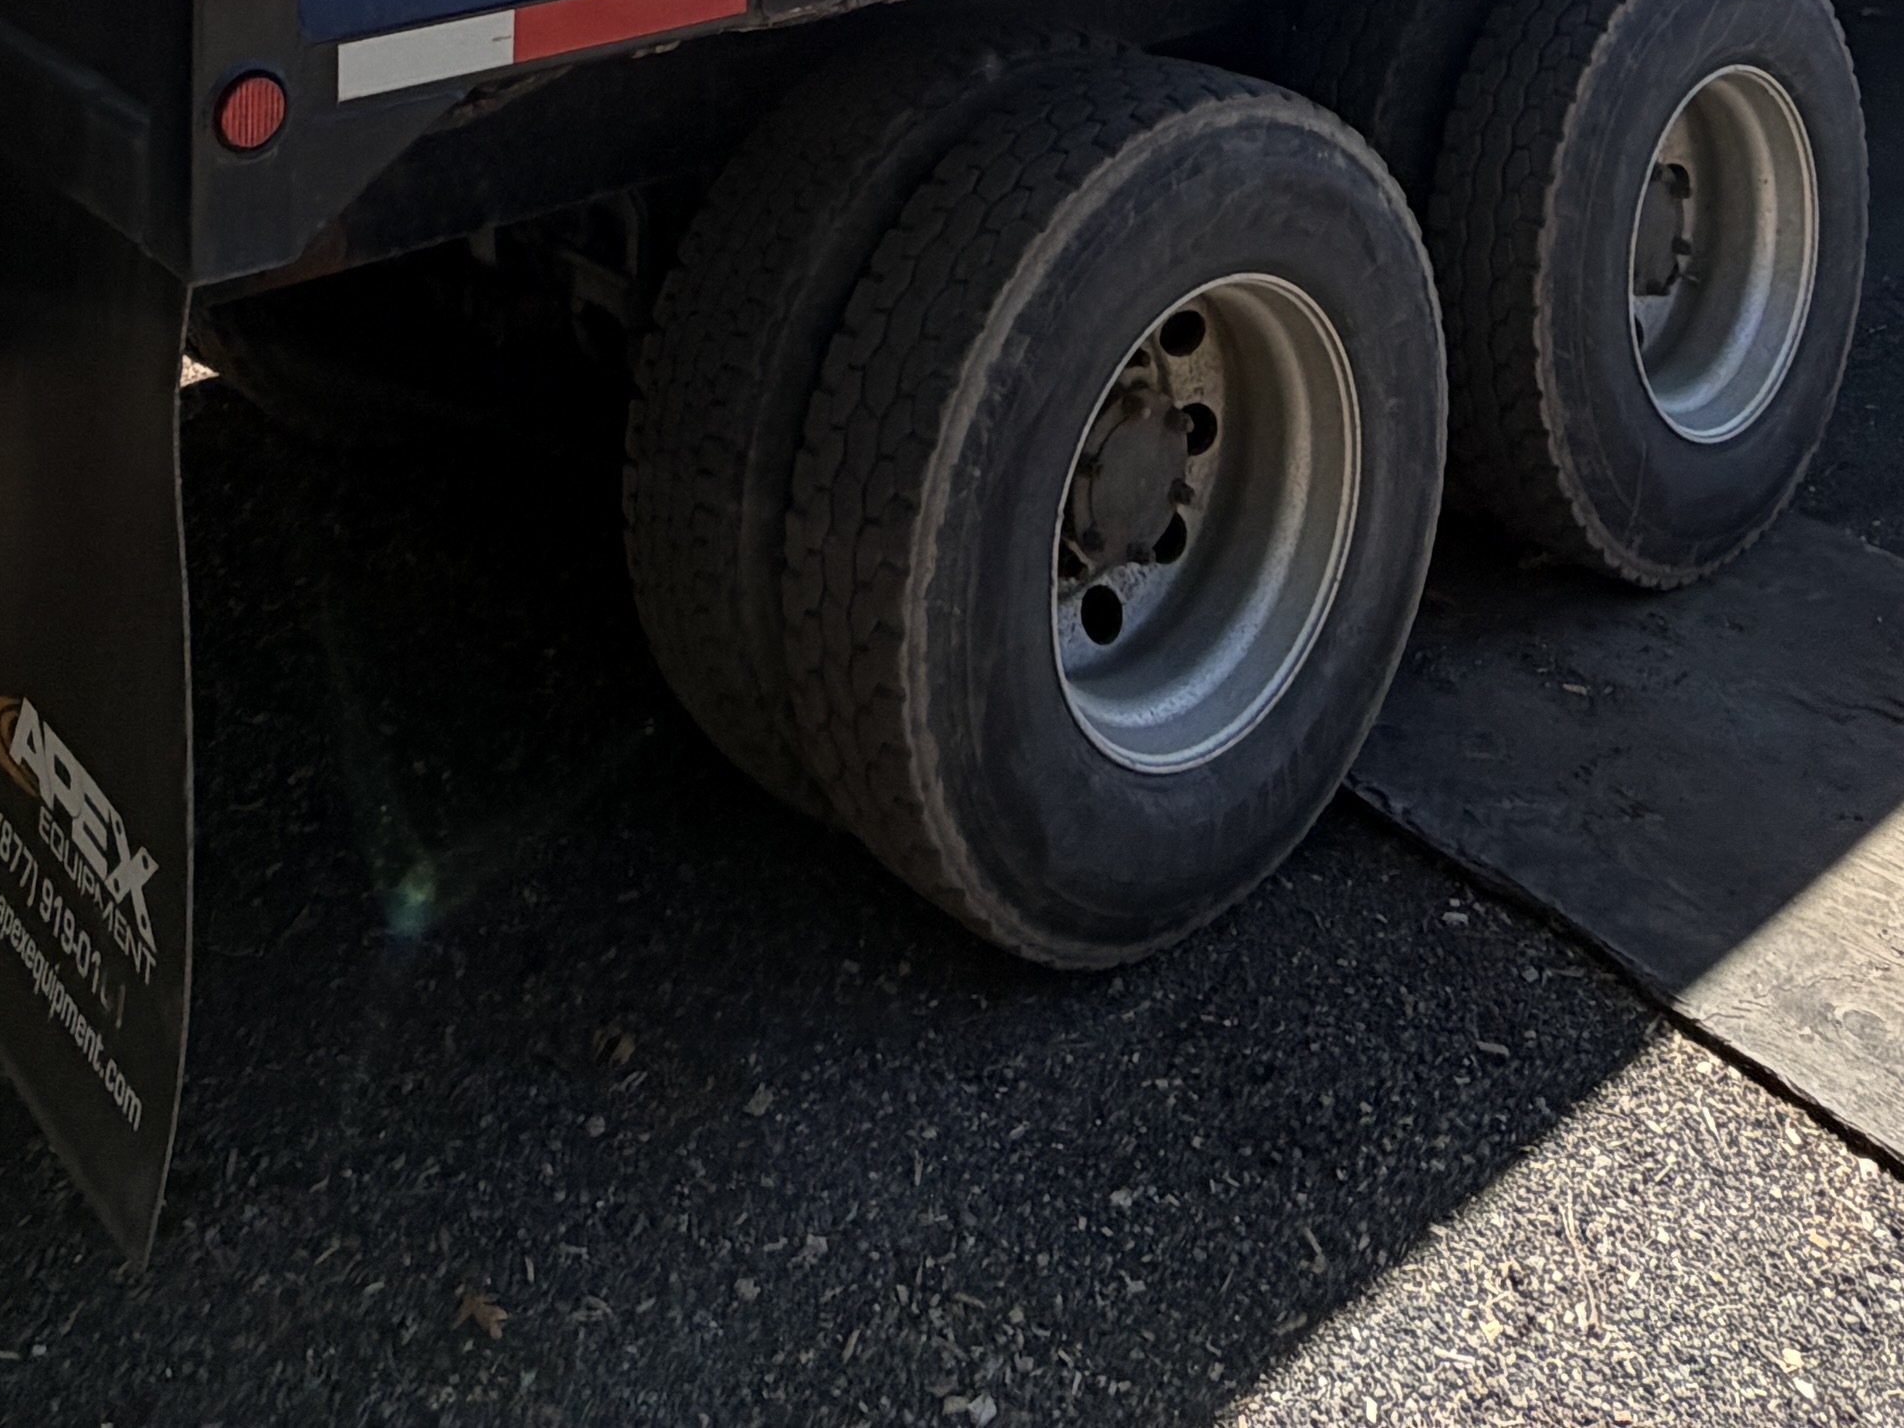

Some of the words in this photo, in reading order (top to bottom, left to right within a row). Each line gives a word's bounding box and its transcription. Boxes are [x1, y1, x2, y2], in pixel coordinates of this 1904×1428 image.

[8, 696, 160, 955] APEX
[38, 805, 157, 986] EQUIPMENT
[39, 878, 127, 1030] 919-01
